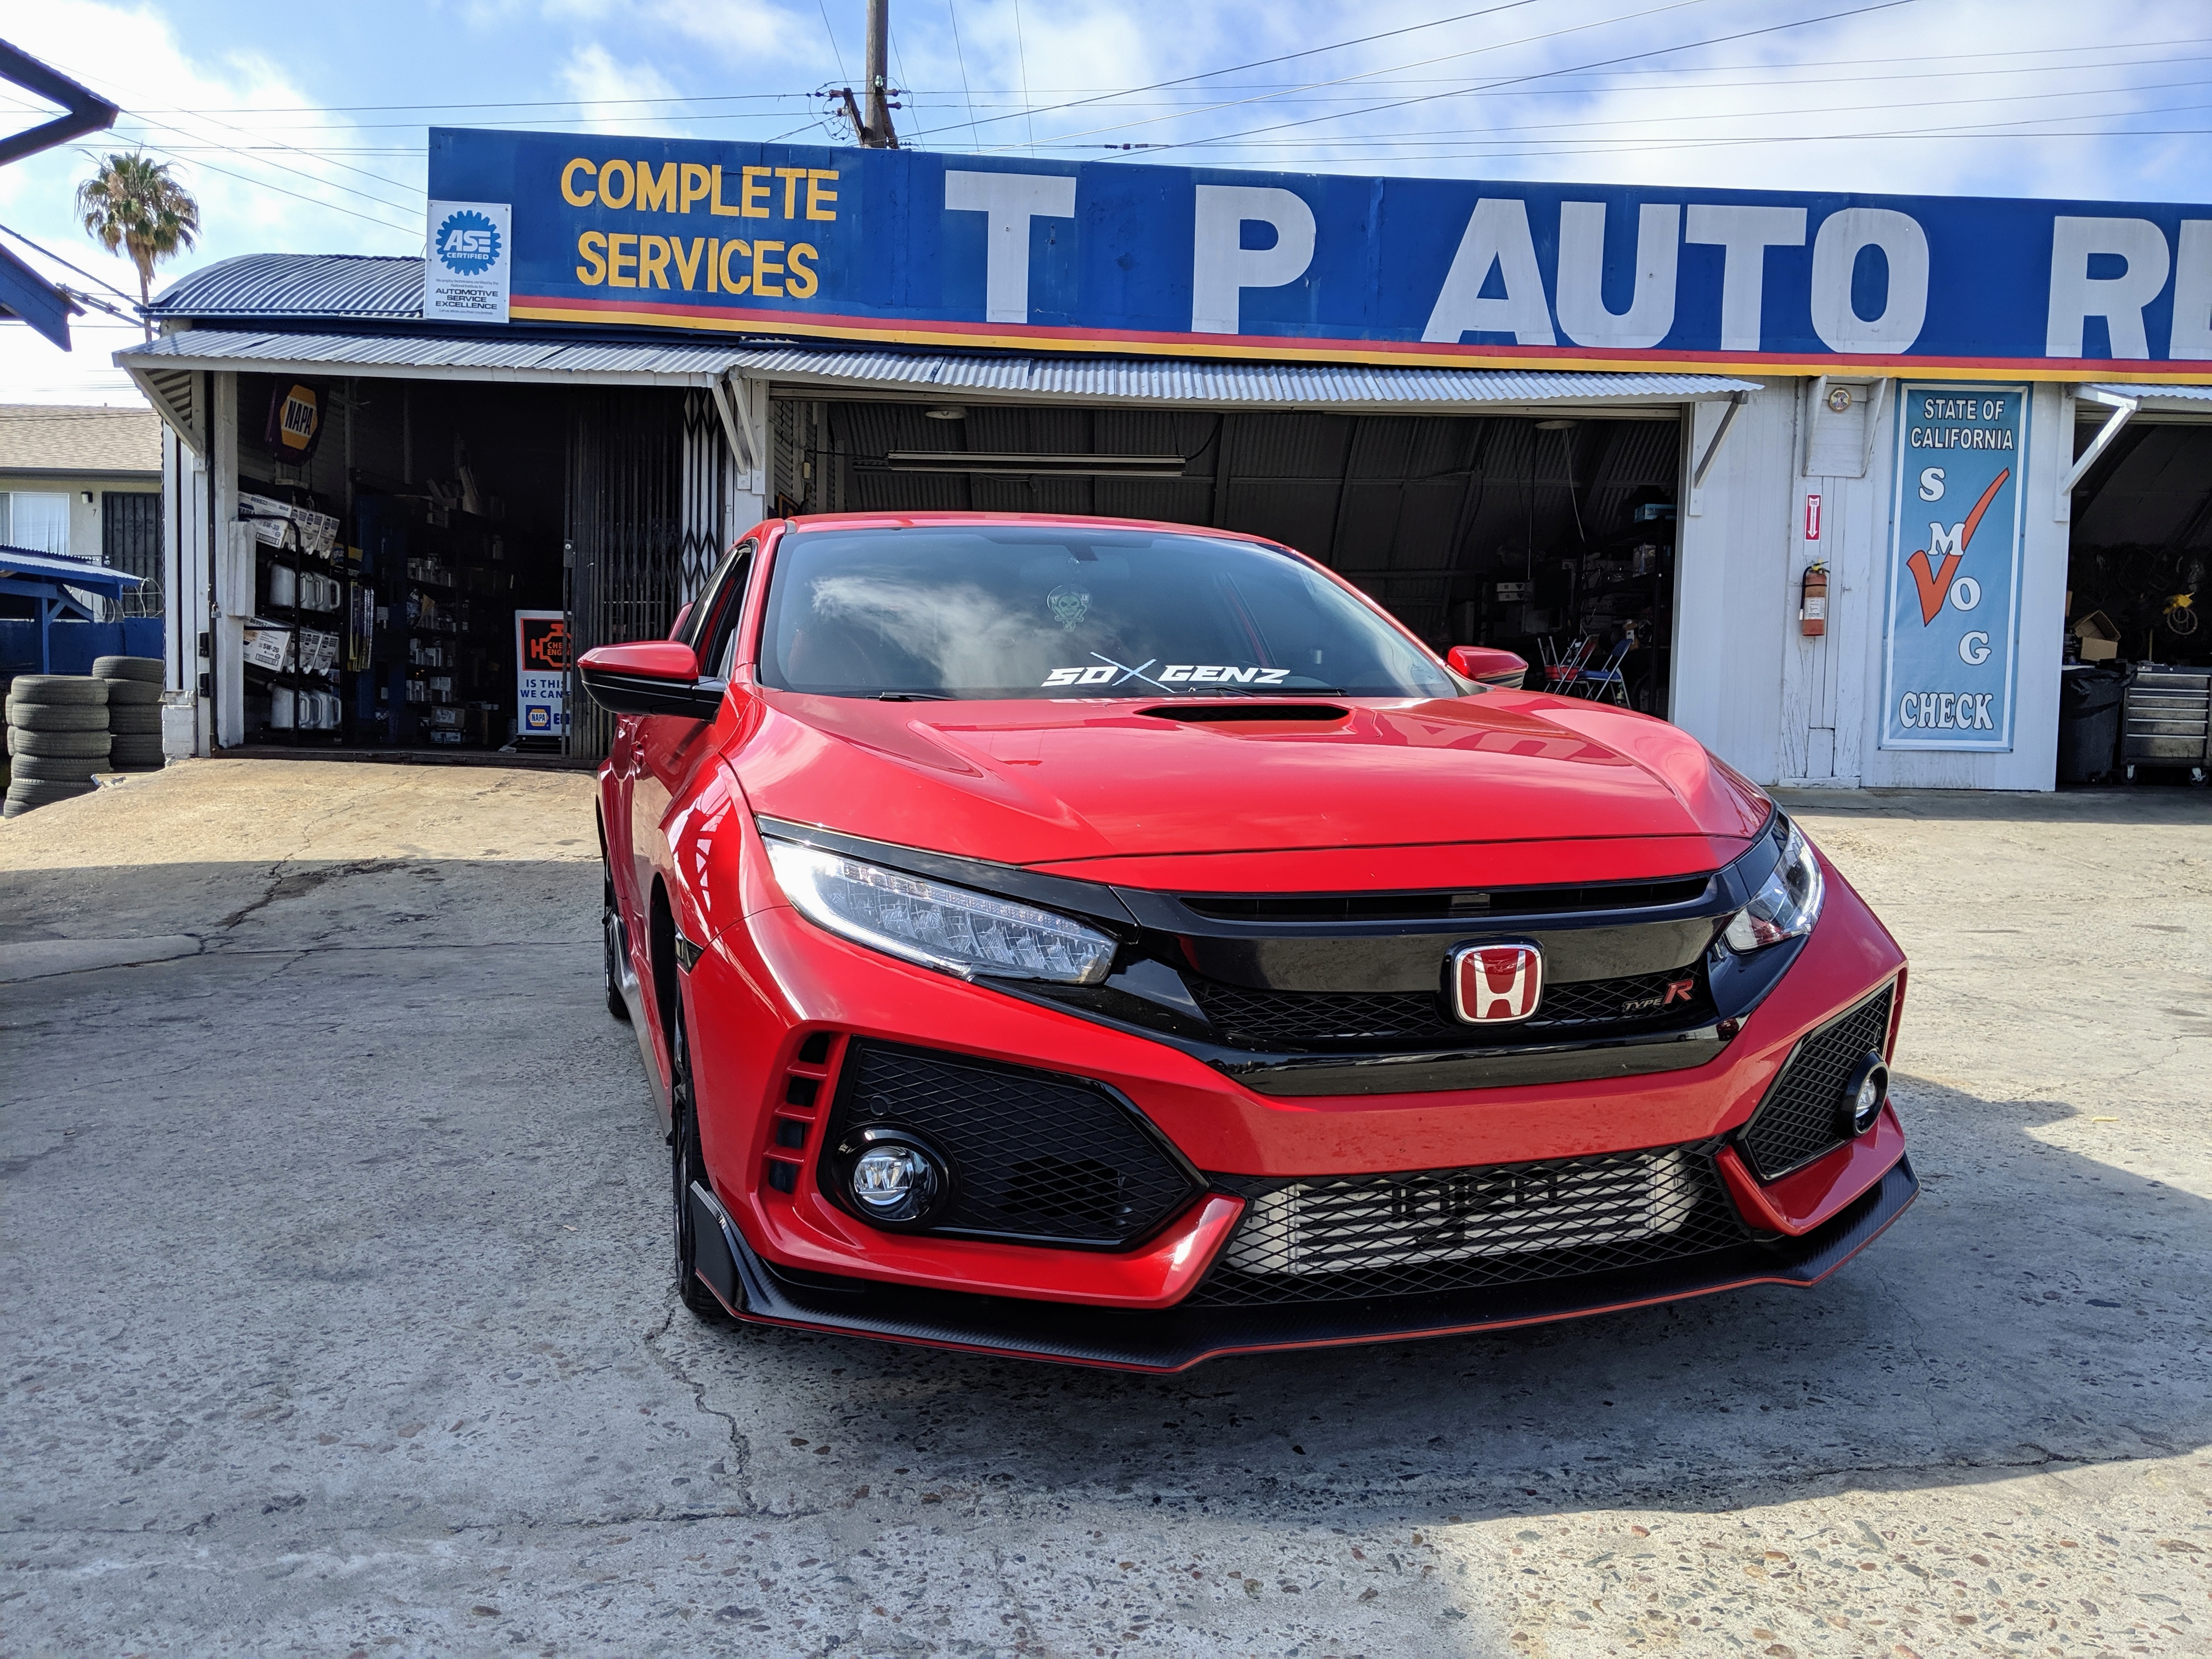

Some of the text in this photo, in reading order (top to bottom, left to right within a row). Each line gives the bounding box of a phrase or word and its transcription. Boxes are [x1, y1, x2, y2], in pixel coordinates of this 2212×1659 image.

[561, 157, 839, 221] COMPLETE
[443, 229, 491, 253] ASE
[447, 252, 489, 260] CERTIFIED
[576, 230, 819, 299] SERVICES
[945, 170, 1076, 324] T
[1192, 184, 1317, 335] P
[1420, 198, 1930, 354] AUTO
[435, 288, 499, 297] AUTOMOTIVE
[436, 301, 498, 309] EXCELLENCE
[284, 400, 314, 436] NAPA
[1924, 398, 2005, 421] STATE OF
[1910, 426, 2015, 452] CALIFORNIA
[92, 508, 97, 517] 7
[263, 643, 280, 653] 5W-20
[520, 689, 537, 698] WE
[540, 690, 563, 698] CAN
[526, 679, 537, 688] IS
[532, 713, 546, 723] NAPA
[1899, 691, 1994, 731] CHECK
[1624, 978, 1694, 1011] TYPE R
